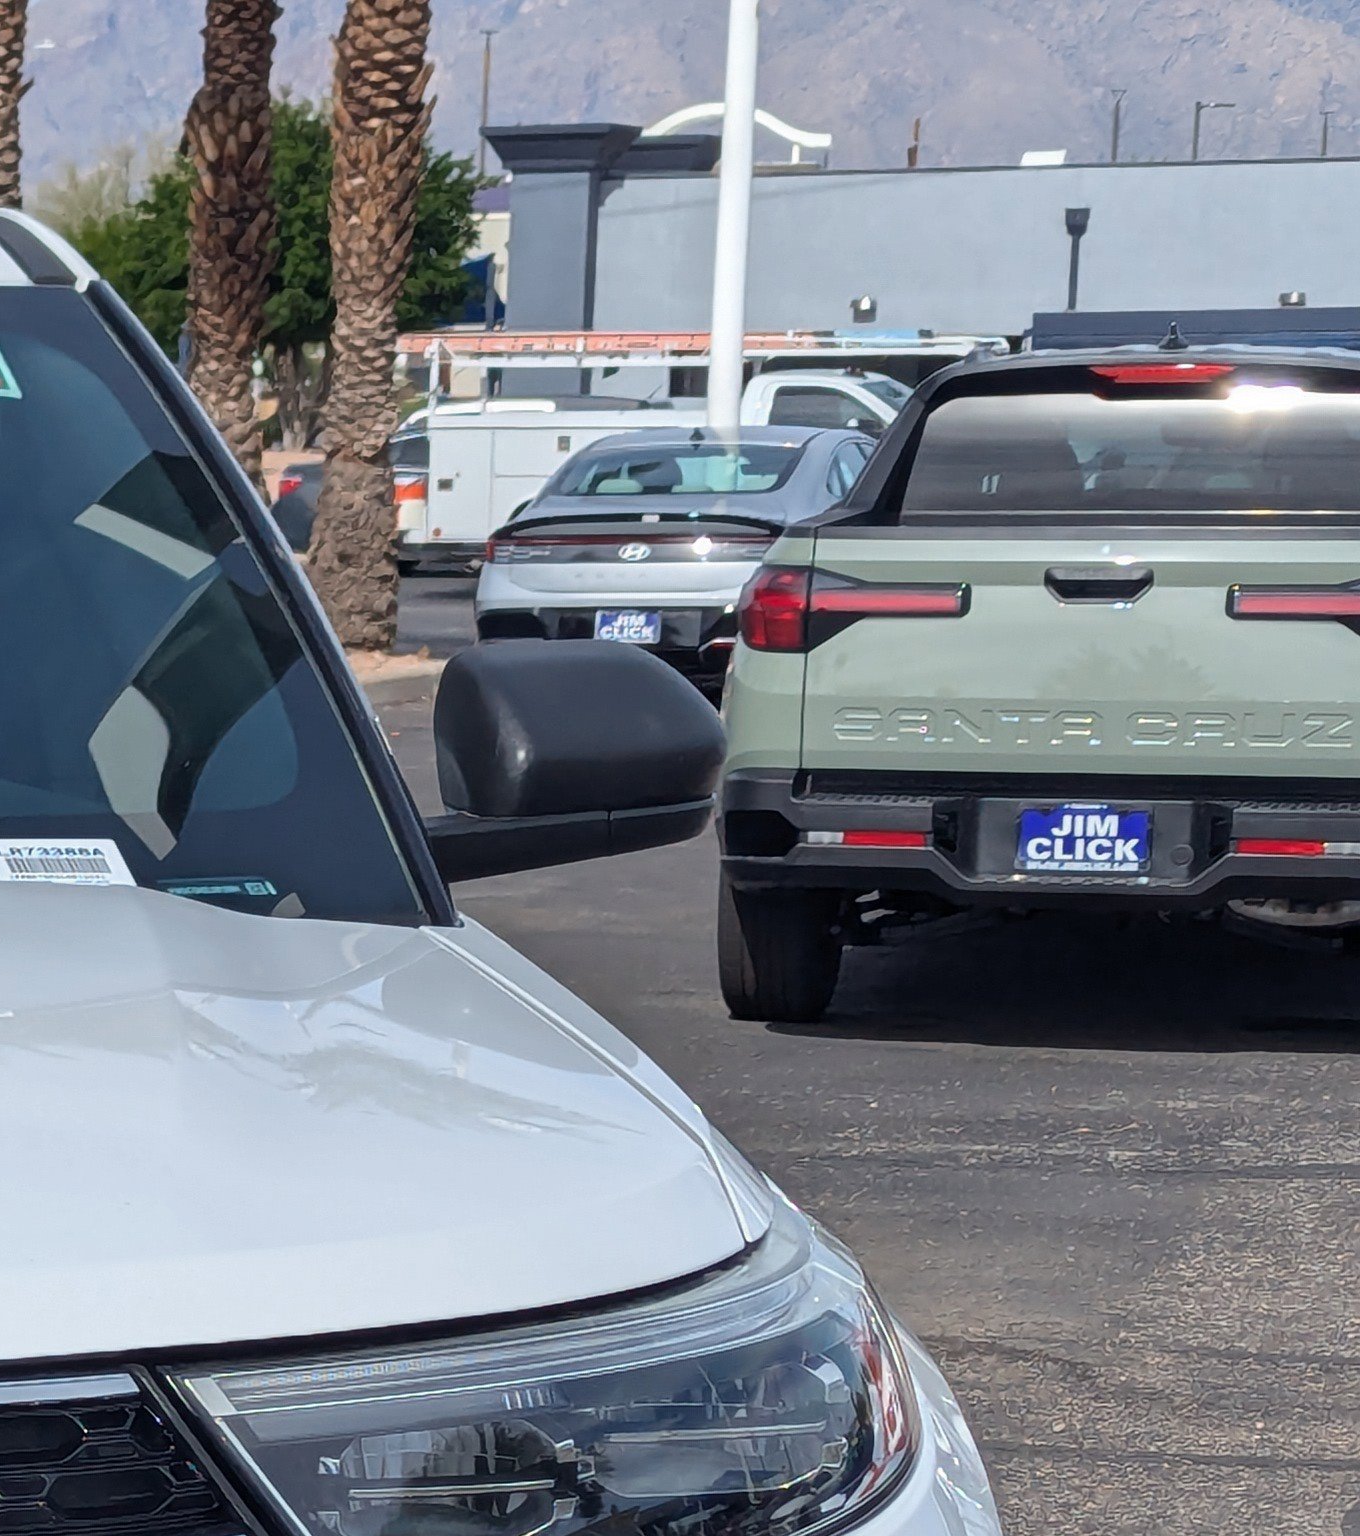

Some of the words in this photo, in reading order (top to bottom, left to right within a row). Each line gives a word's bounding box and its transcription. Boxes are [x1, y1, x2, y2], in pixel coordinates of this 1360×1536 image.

[612, 613, 647, 627] JIM
[600, 625, 655, 640] CLICK
[833, 707, 1103, 745] SANTA
[1124, 710, 1355, 748] CRUZ
[1050, 814, 1120, 838] JIM
[1026, 837, 1140, 862] CLICK
